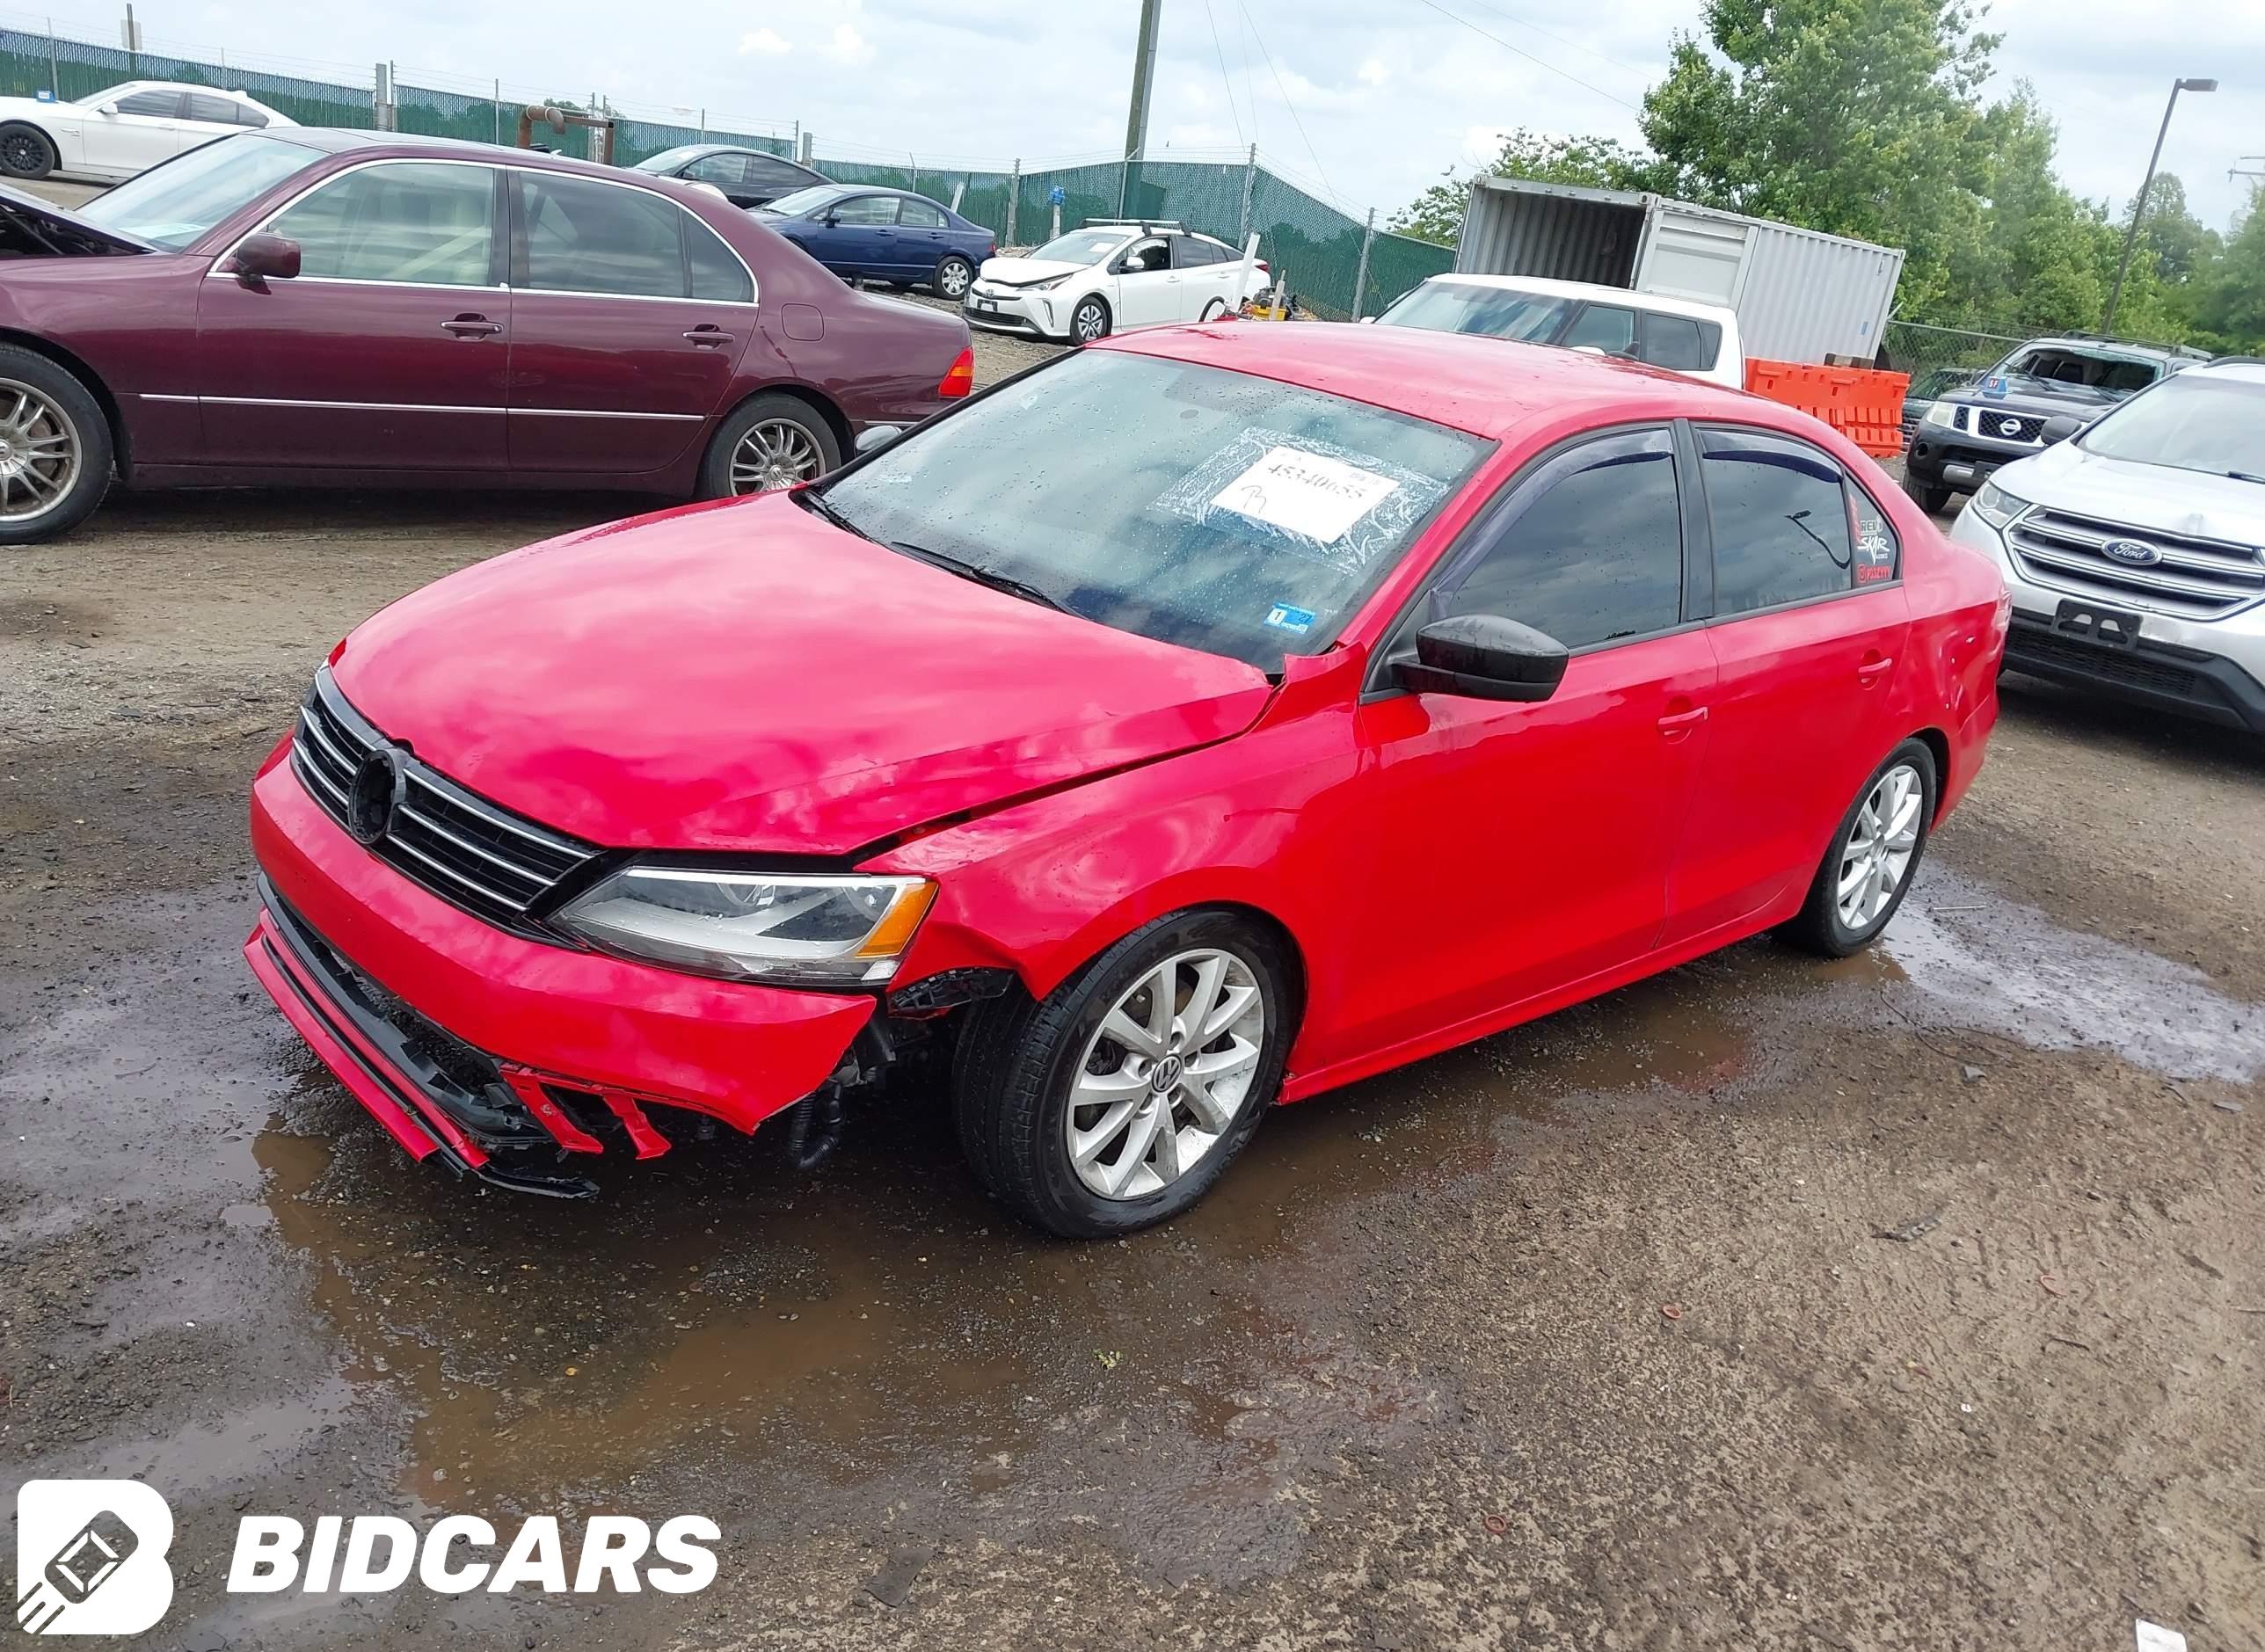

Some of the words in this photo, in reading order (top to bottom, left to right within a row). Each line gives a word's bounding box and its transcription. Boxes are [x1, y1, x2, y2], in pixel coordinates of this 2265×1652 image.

[1857, 535, 1890, 563] SKAR
[2113, 542, 2148, 559] Ford
[1273, 611, 1282, 621] 1
[1299, 613, 1314, 623] 27
